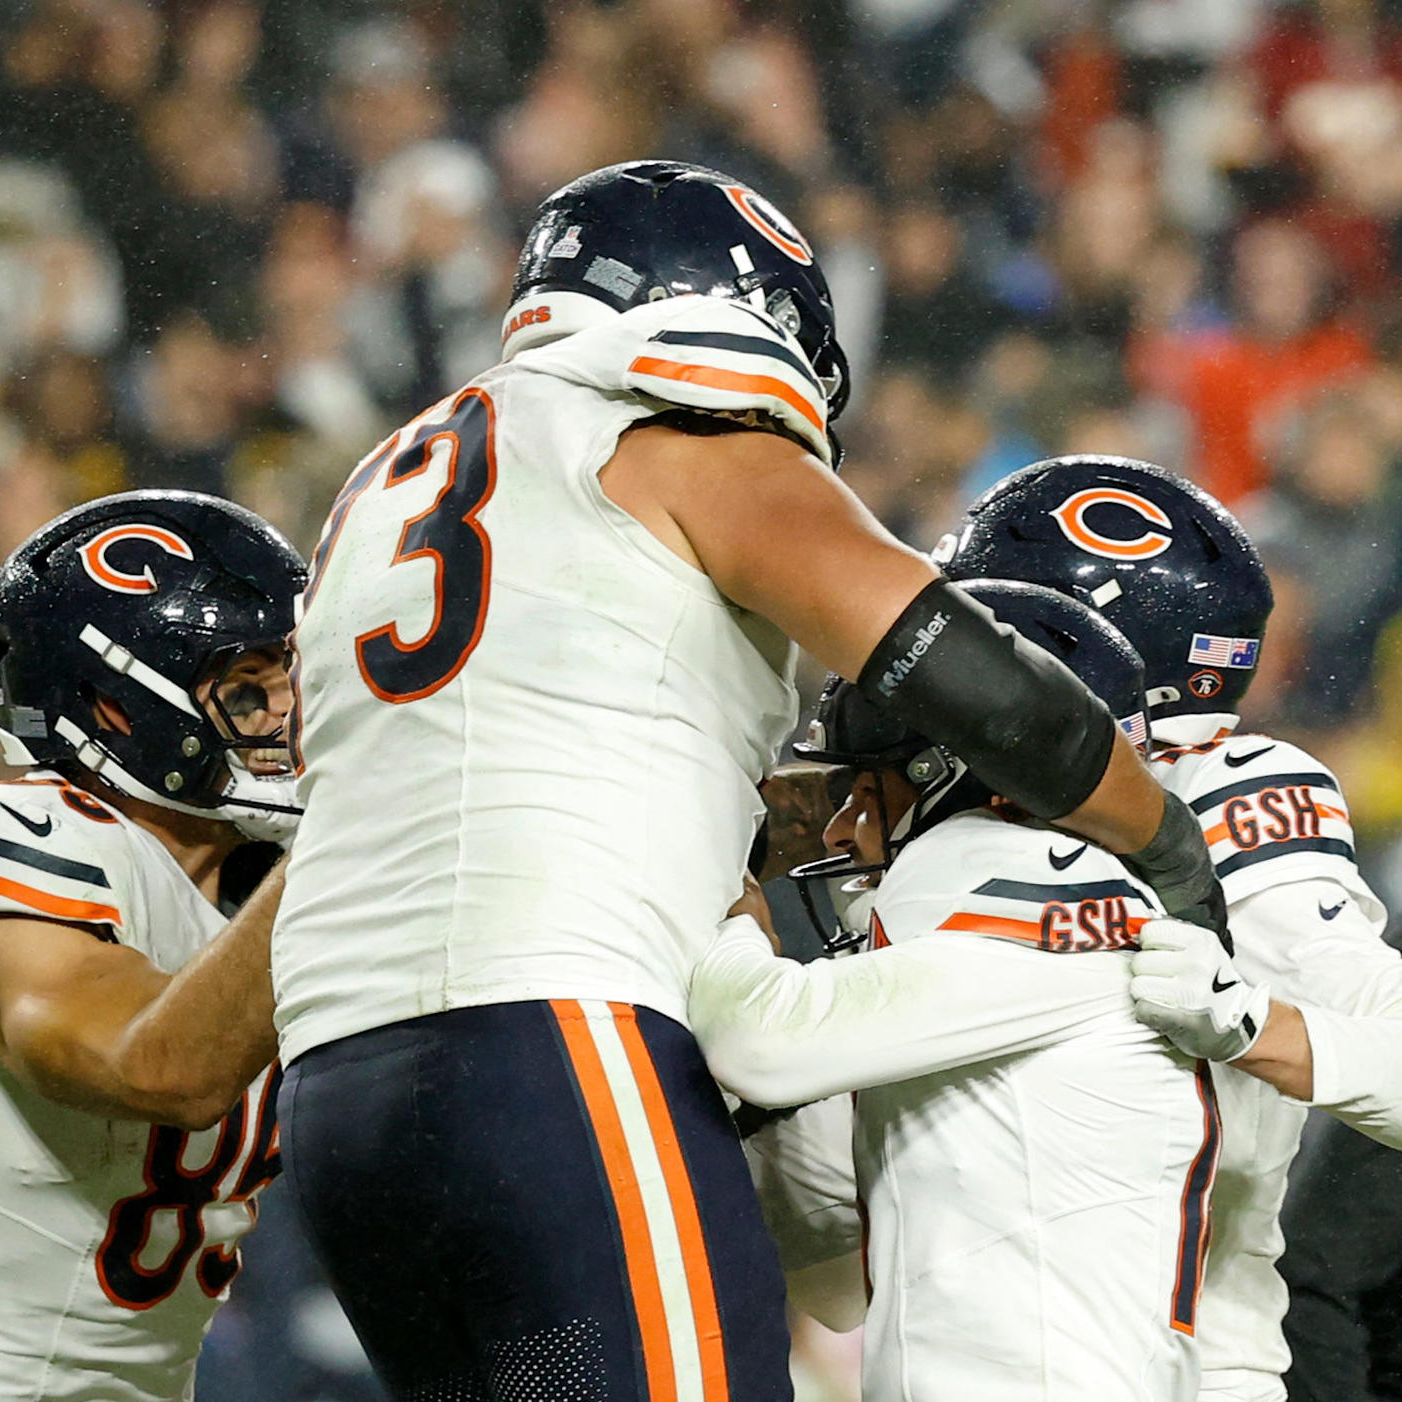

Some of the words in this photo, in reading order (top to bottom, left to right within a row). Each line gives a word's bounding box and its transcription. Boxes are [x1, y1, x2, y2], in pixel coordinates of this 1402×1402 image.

[77, 523, 194, 595] C
[1050, 487, 1173, 560] C
[882, 611, 949, 688] Mueller
[1223, 784, 1321, 852] GSH
[1039, 896, 1130, 953] GSH
